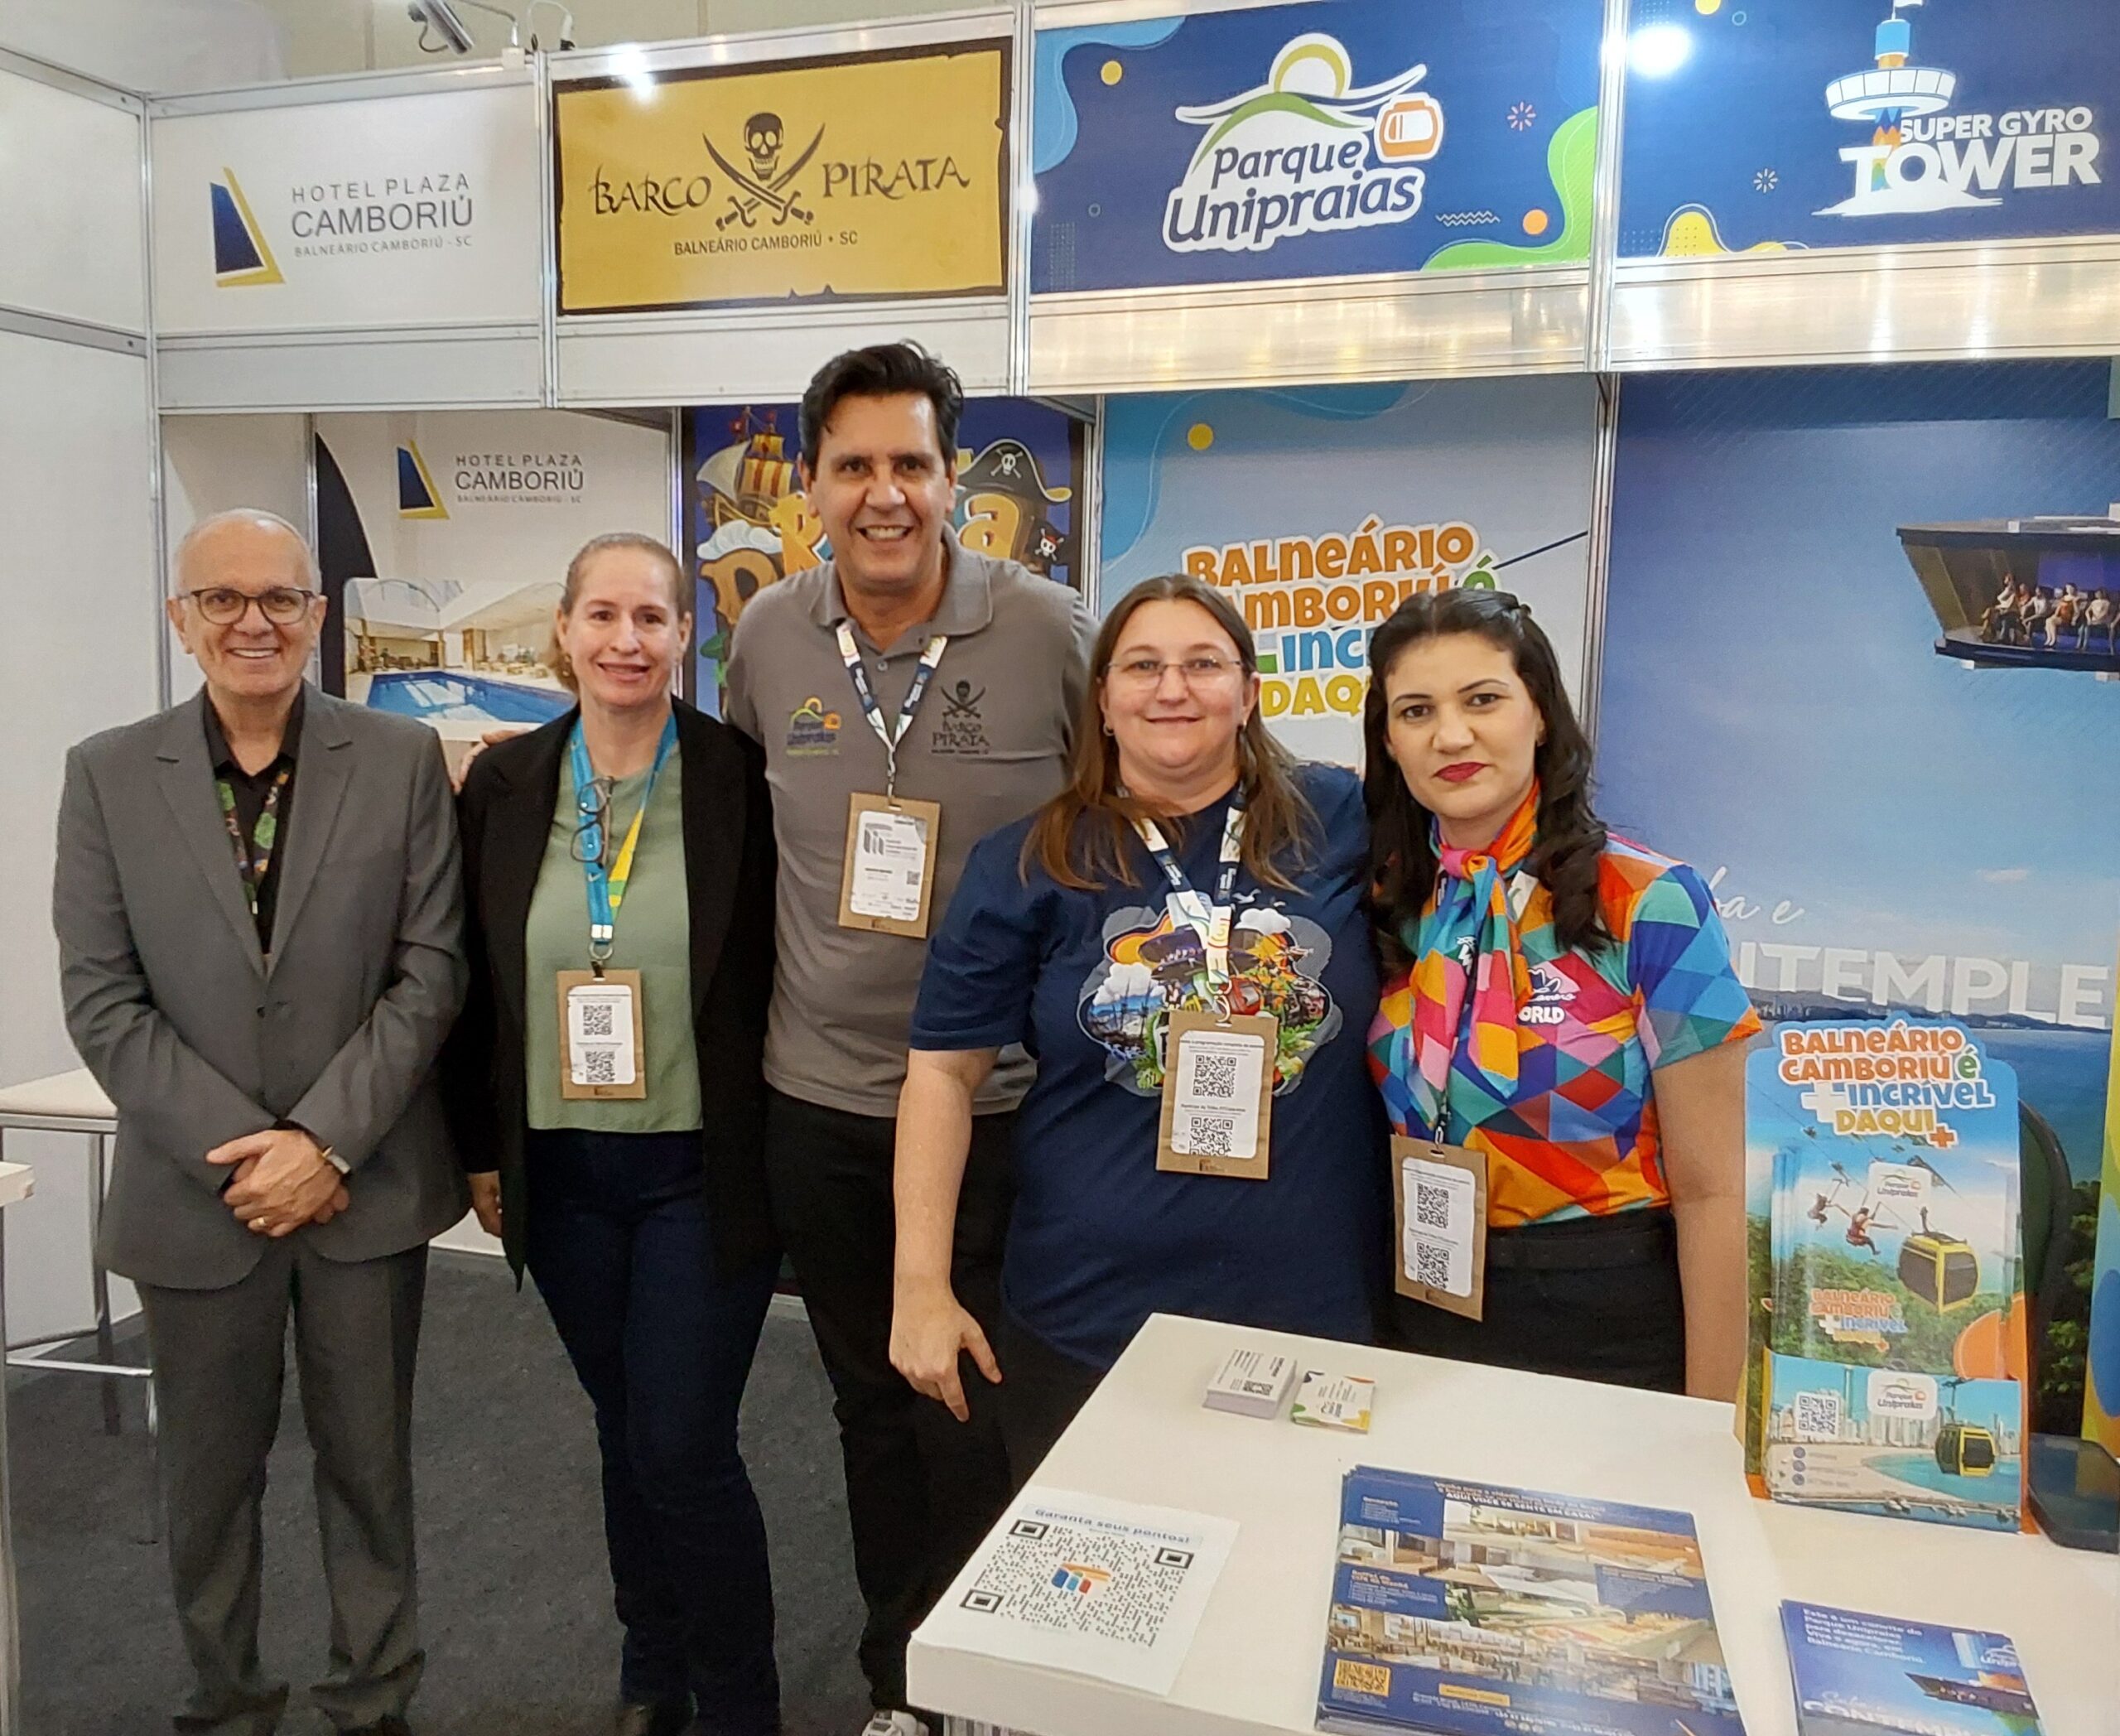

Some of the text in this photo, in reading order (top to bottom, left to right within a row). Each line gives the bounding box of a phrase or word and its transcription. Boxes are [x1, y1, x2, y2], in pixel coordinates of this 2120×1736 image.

[1900, 106, 2094, 143] SUPER GYRO
[1212, 139, 1363, 188] Parque
[1838, 131, 2102, 200] TOWER
[292, 173, 469, 203] HOTEL PLAZA
[589, 156, 970, 216] BARCO PIRATA
[292, 195, 472, 238] CAMBORIÚ
[1168, 170, 1417, 244] Unipraias
[456, 235, 472, 247] SC
[674, 229, 858, 256] BALNEÁRIO CAMBORIÚ SC
[456, 455, 582, 466] HOTEL PLAZA
[455, 469, 584, 490] CAMBORIÚ
[1261, 674, 1371, 717] DAQ
[1739, 942, 2109, 1029] TEMPLE
[1517, 1005, 1565, 1025] ORLD
[1096, 1521, 1129, 1531] seus
